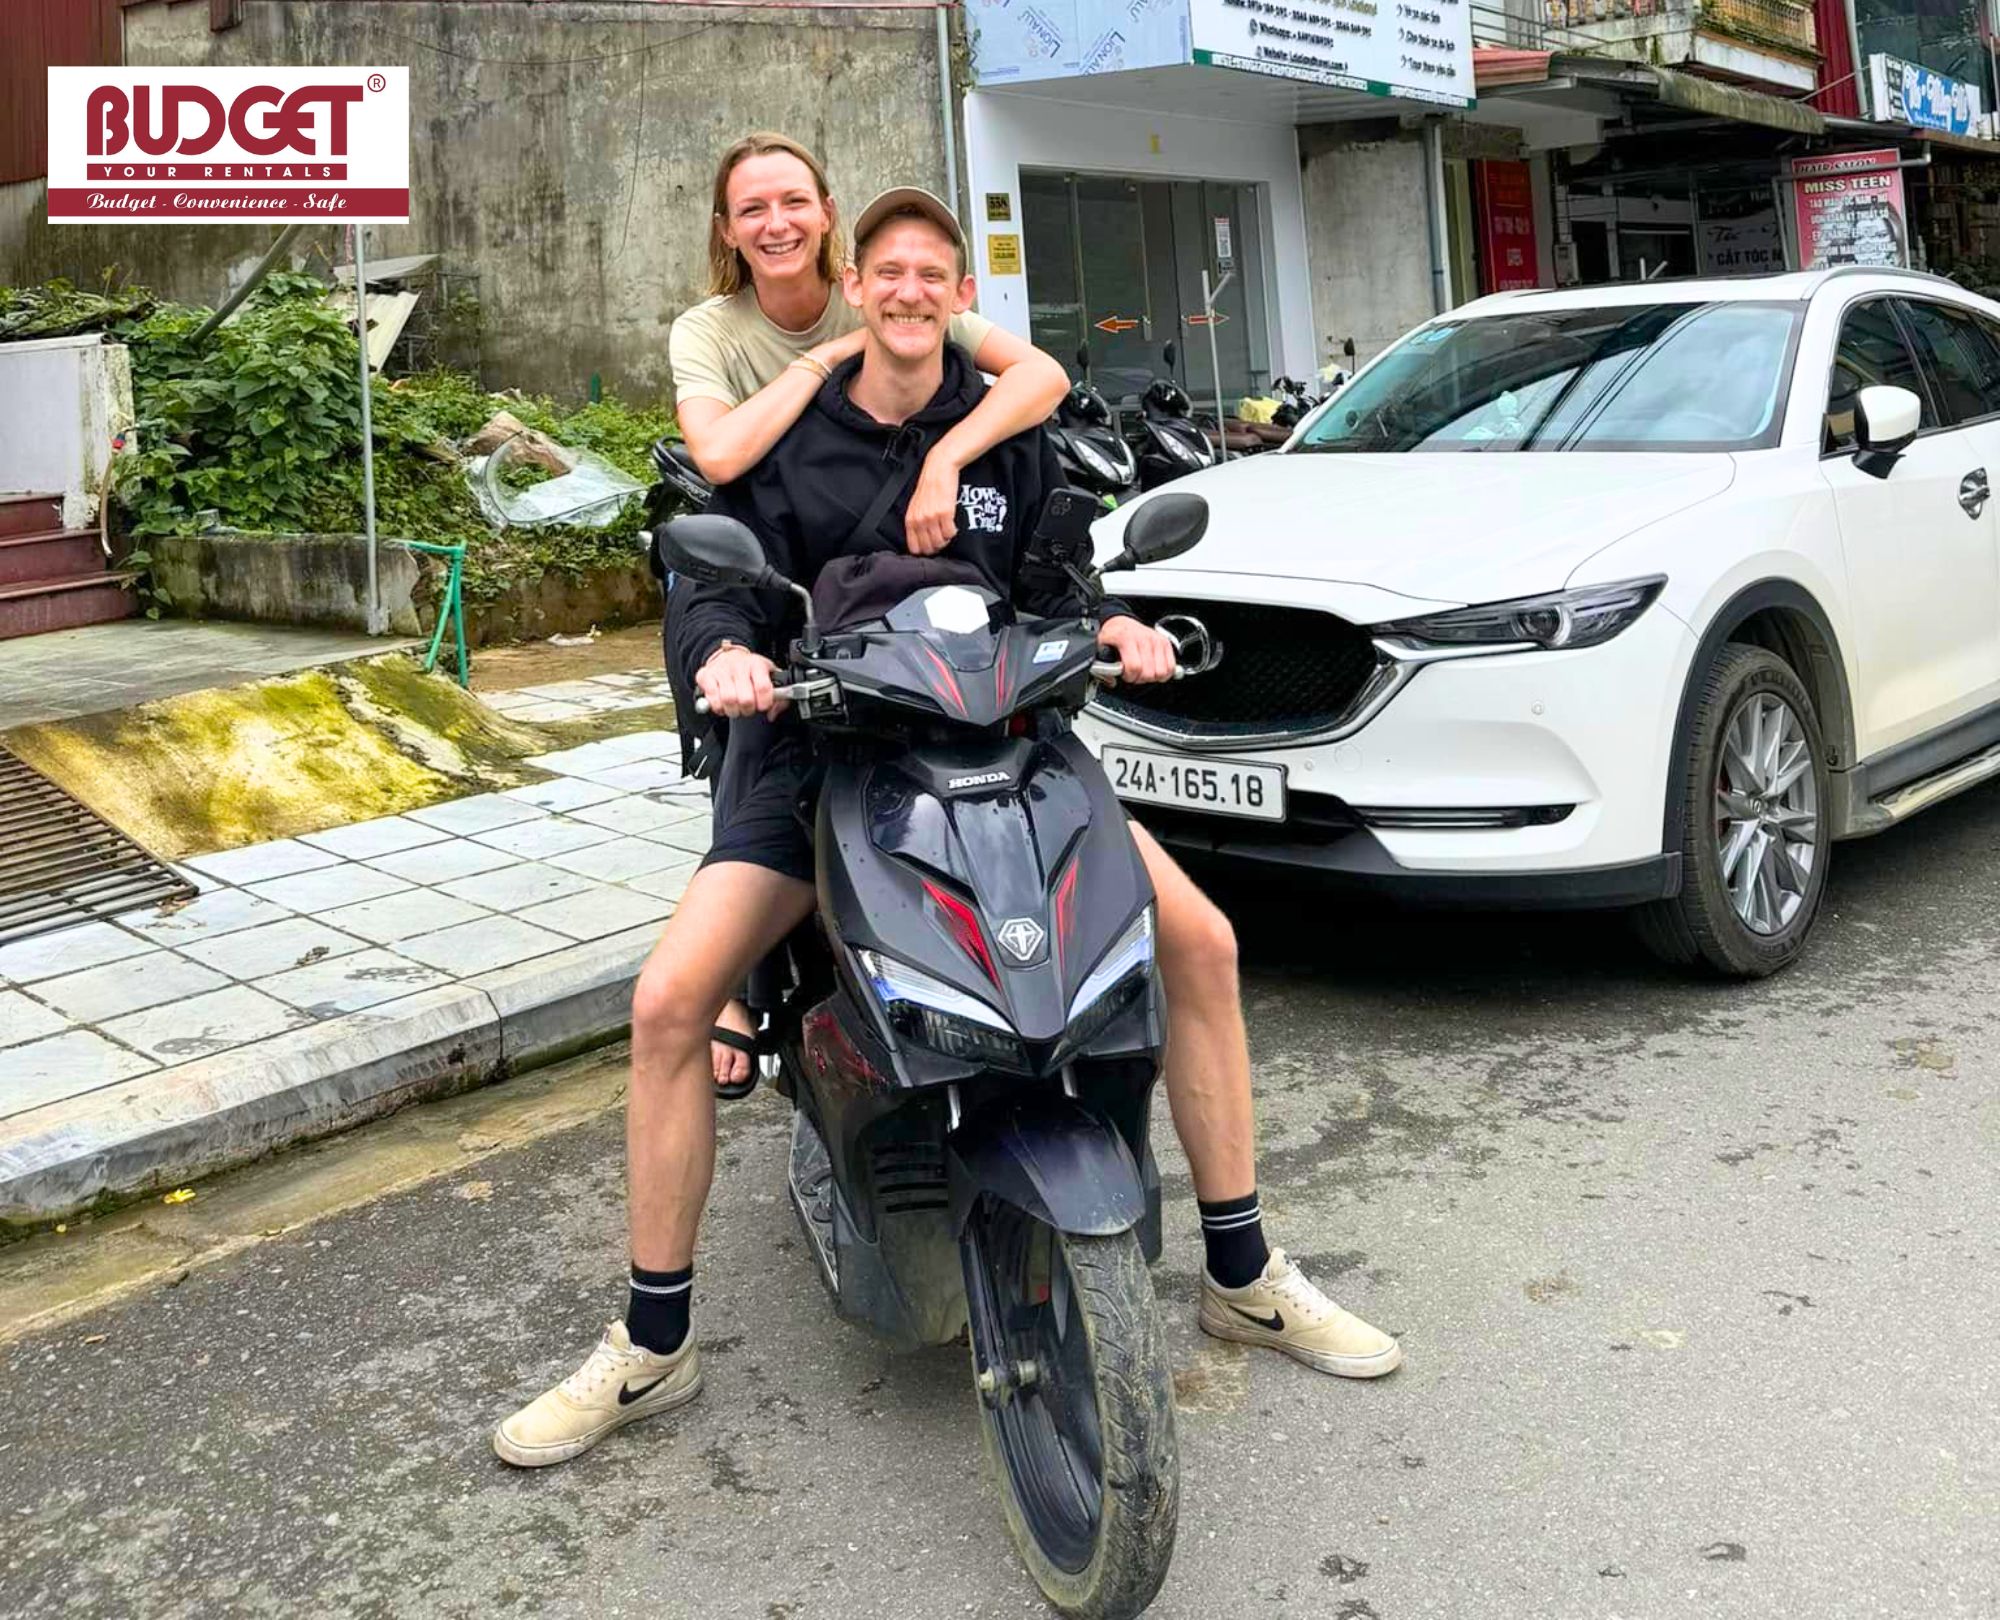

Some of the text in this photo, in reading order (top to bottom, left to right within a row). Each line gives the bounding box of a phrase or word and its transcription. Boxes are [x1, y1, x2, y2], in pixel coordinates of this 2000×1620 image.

[1804, 175, 1892, 194] MISS TEEN
[957, 484, 996, 505] Love
[948, 771, 1011, 789] HONDA
